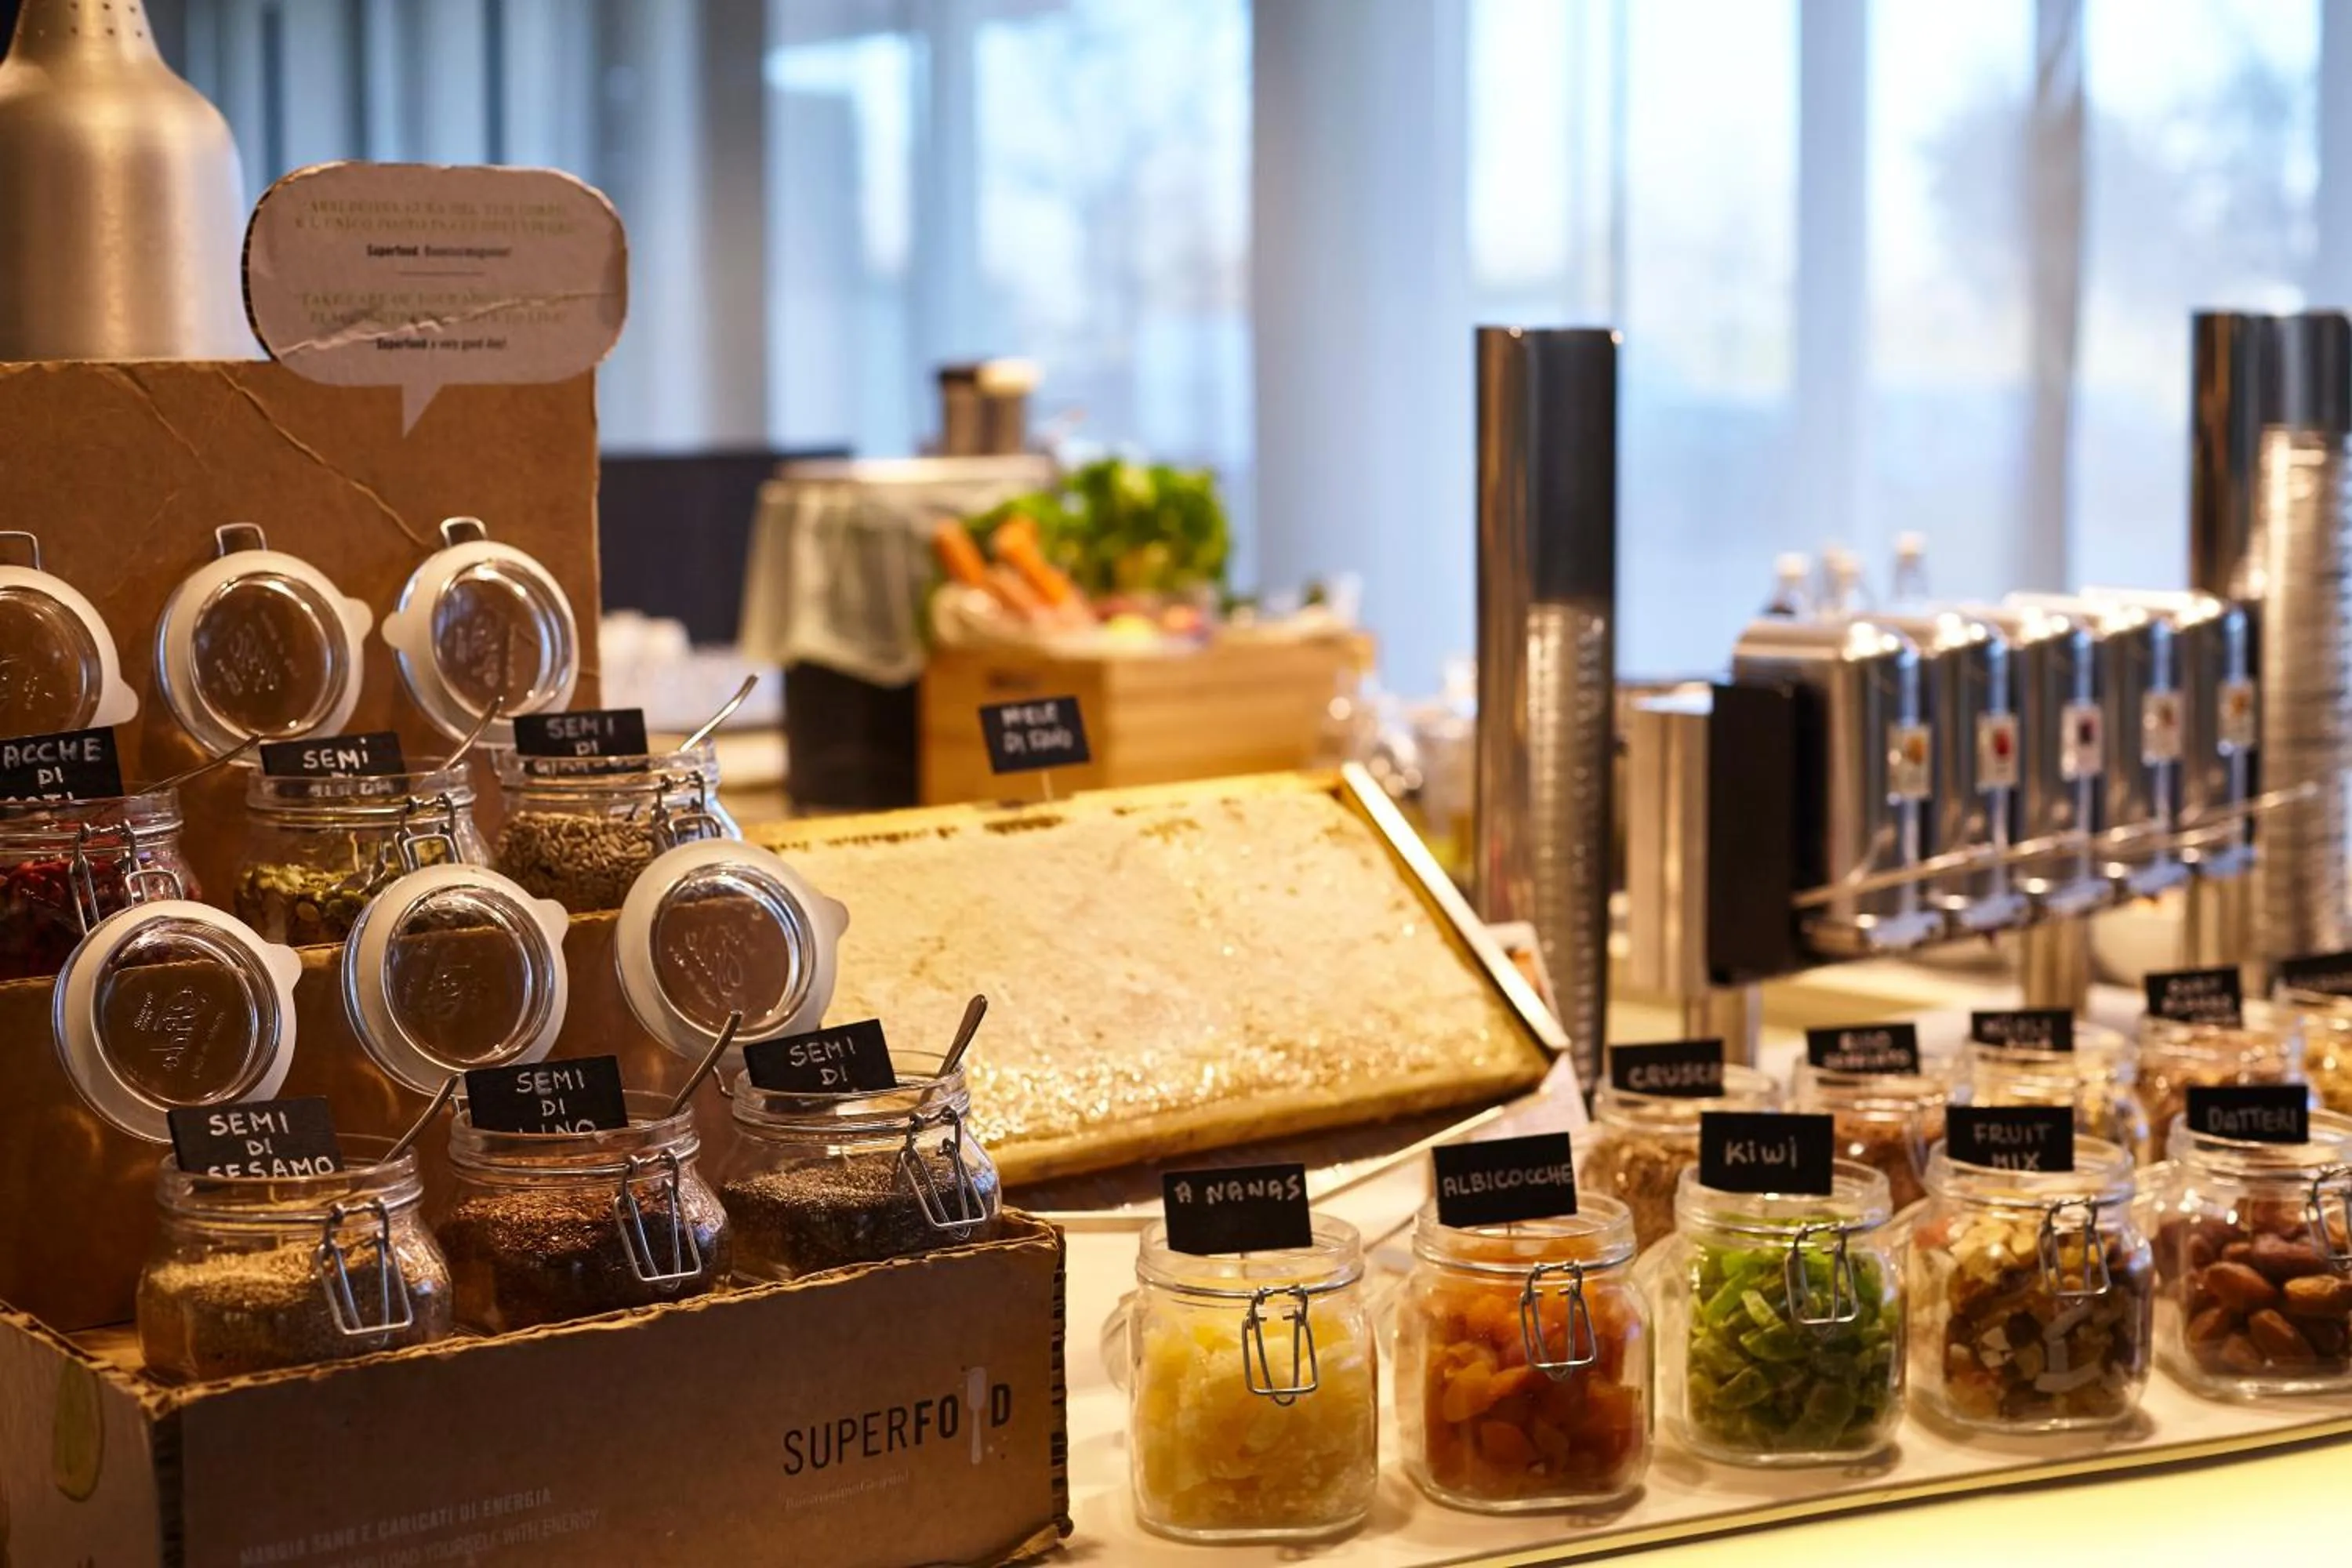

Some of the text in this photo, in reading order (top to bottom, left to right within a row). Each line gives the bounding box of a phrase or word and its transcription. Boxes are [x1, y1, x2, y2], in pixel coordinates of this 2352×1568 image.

[546, 716, 615, 739] SEMI
[303, 737, 369, 770] SEMI
[575, 739, 599, 757] DI
[38, 766, 64, 787] DI
[789, 1036, 857, 1067] SEMI
[516, 1068, 585, 1096] SEMI
[820, 1065, 848, 1086] DI
[541, 1097, 566, 1117] DI
[208, 1110, 290, 1137] SEMI
[1973, 1122, 2055, 1145] FRUIT
[245, 1138, 274, 1156] DI
[1991, 1150, 2042, 1171] MIX
[1443, 1163, 1574, 1199] ALBICOCCHE
[376, 1503, 453, 1541] CARICATI
[459, 1501, 477, 1523] DI
[483, 1486, 554, 1518] ENERGIA
[542, 1507, 601, 1538] ENERGY
